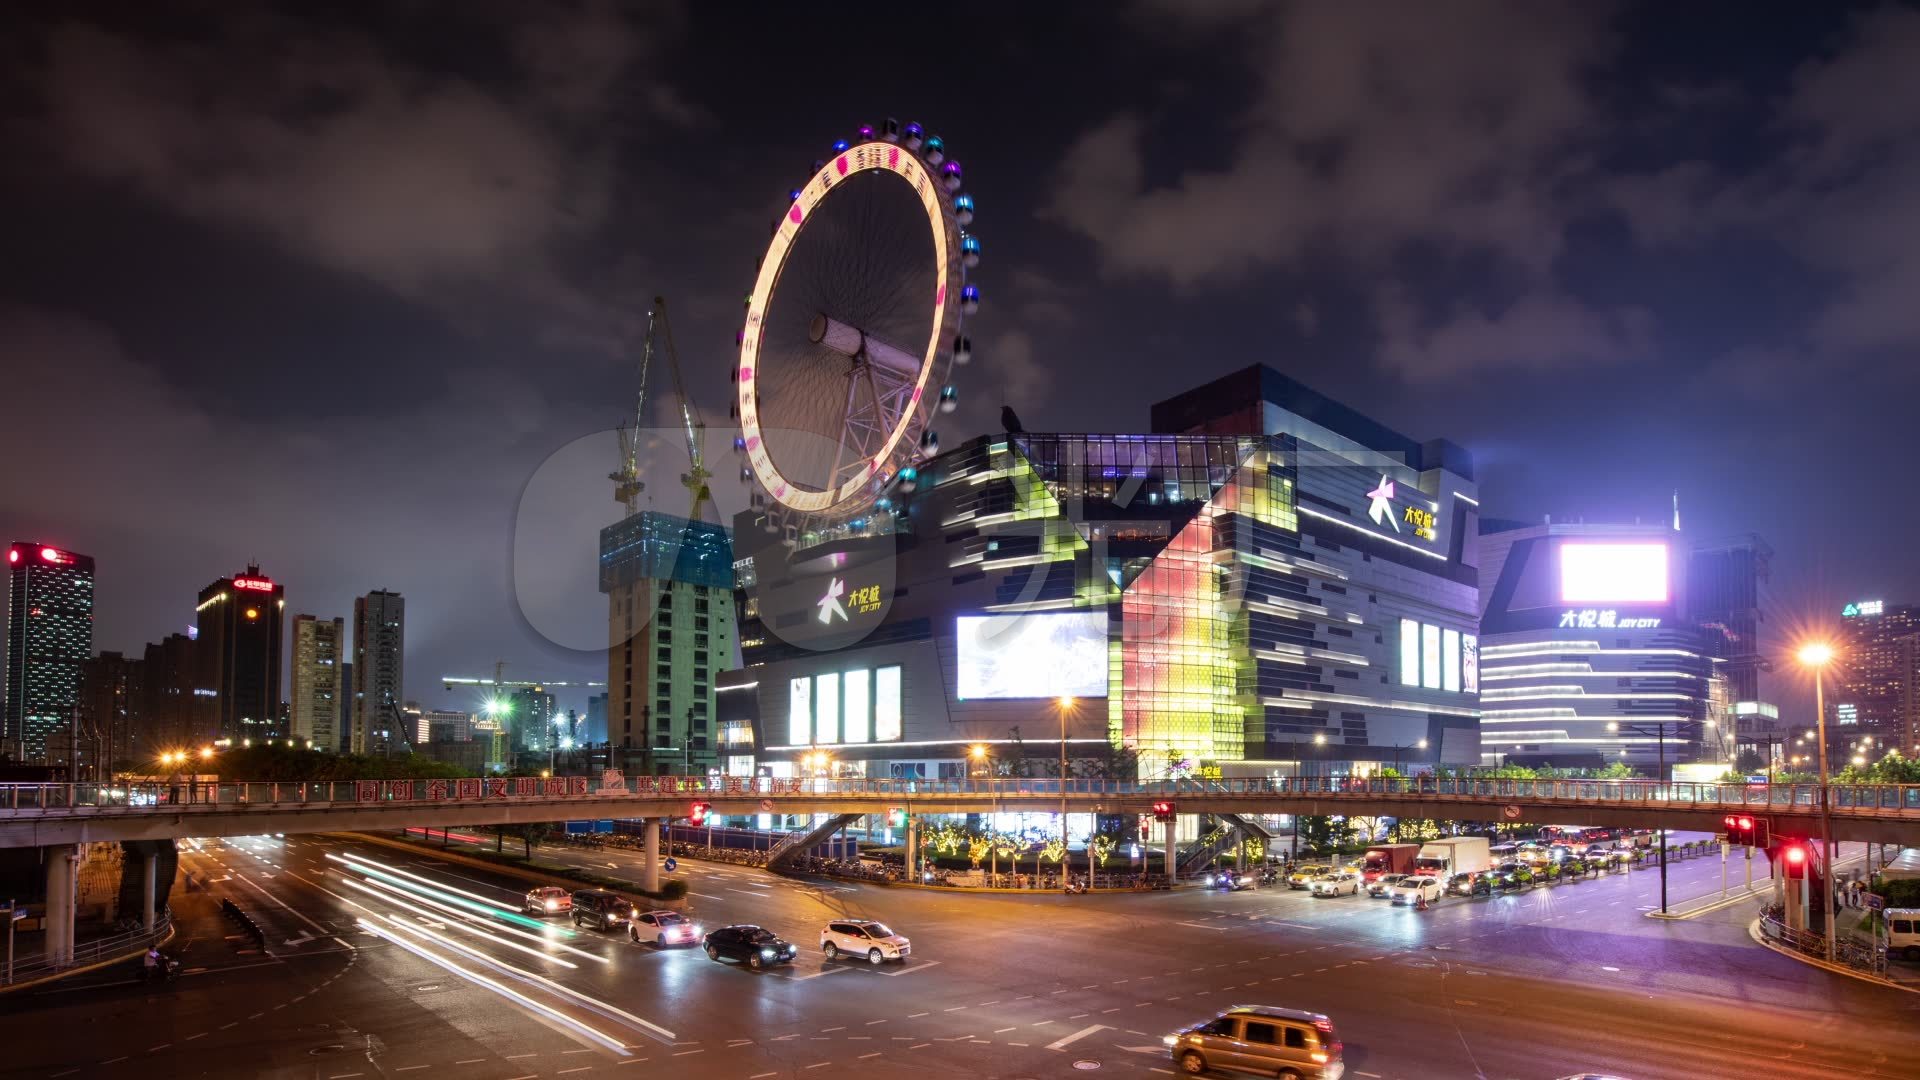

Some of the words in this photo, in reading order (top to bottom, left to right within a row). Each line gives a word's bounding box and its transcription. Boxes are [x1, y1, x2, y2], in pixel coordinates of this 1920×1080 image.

[1404, 506, 1432, 529] 大悦城
[848, 585, 880, 608] 大悦城
[1559, 609, 1617, 628] 大悦城
[1617, 618, 1637, 628] JOY
[1637, 618, 1661, 628] CITY
[356, 777, 587, 803] 同创全国文明城区
